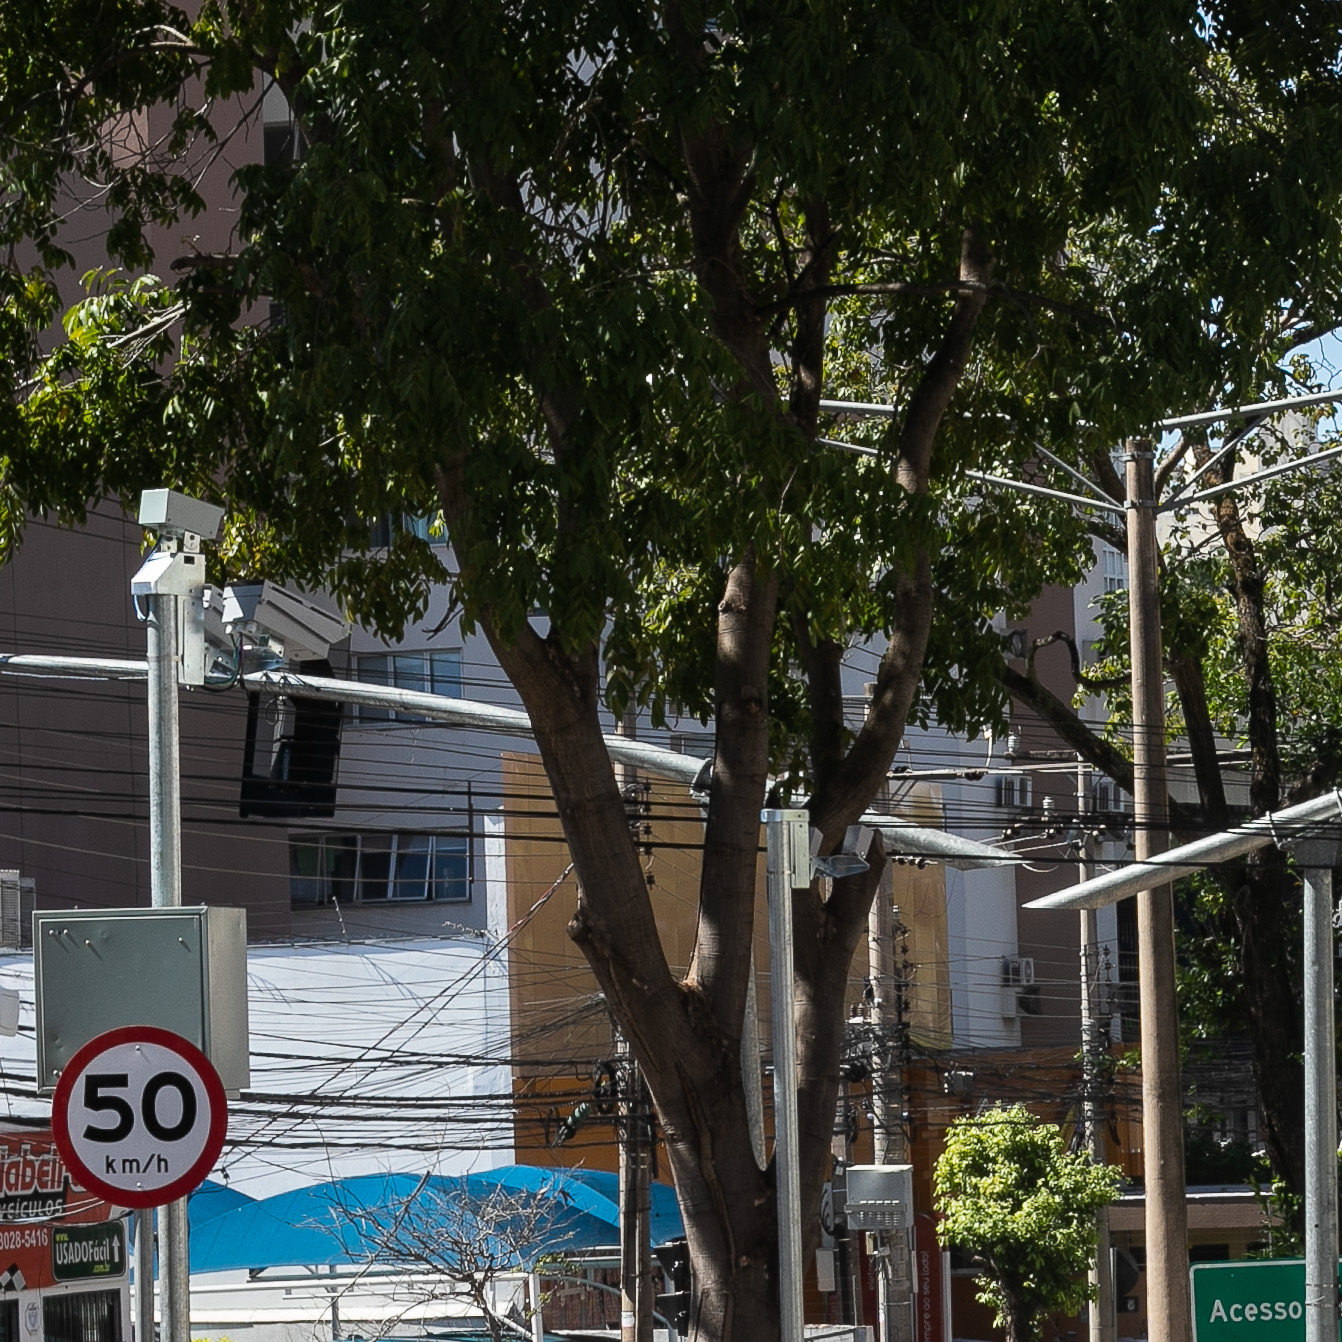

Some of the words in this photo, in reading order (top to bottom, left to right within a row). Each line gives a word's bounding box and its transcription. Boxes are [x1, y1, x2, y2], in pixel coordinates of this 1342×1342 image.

[83, 1071, 197, 1143] 50
[105, 1153, 169, 1175] km/h
[1209, 1299, 1303, 1323] Acesso
